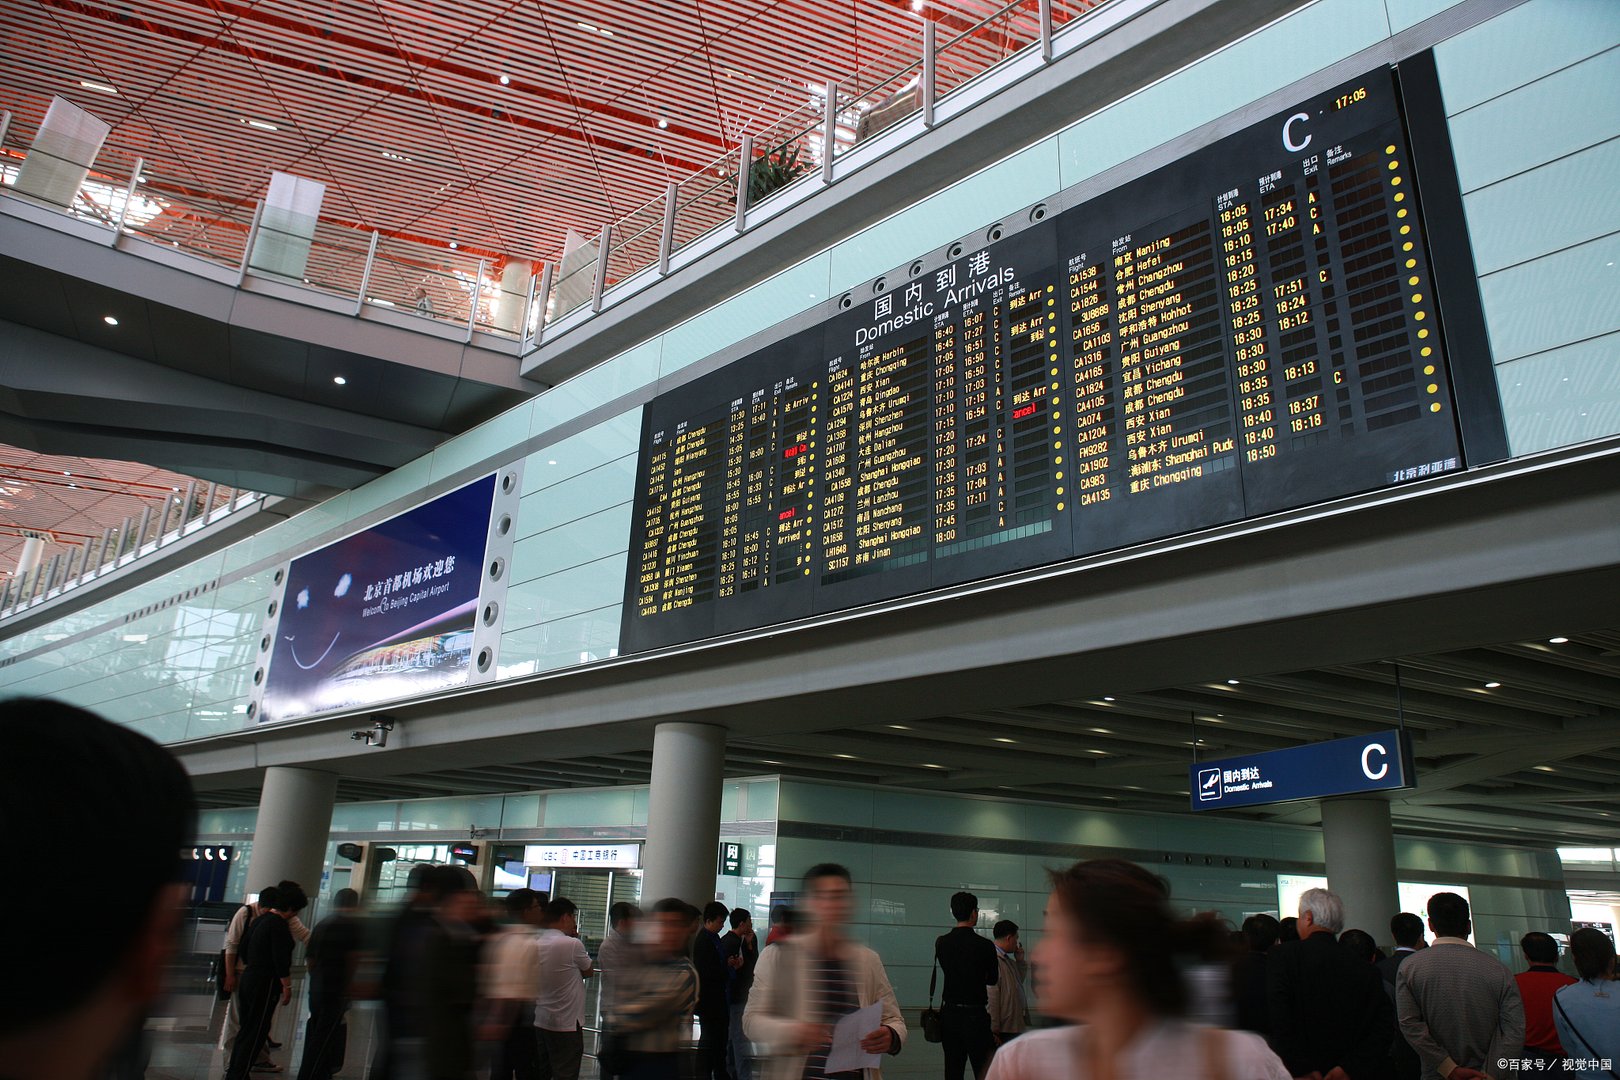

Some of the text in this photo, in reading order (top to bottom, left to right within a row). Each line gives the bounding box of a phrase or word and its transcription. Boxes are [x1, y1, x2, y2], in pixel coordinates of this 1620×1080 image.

[1336, 88, 1366, 109] 17:05
[1282, 113, 1312, 152] C
[1303, 155, 1318, 167] 出口
[1304, 165, 1318, 176] Exit
[1327, 151, 1352, 166] Remarks
[1218, 201, 1232, 211] STA
[1260, 183, 1275, 194] ETA
[1070, 204, 1247, 284] CA1538 南京 Nanjing 18:05
[1070, 192, 1315, 298] CA1544 合肥 Hefei 18:05 17:34 A
[1072, 208, 1317, 312] CA1826 常州 Changzhou 18:10 17:40 C
[1112, 245, 1128, 255] From
[1118, 294, 1136, 310] 成都
[1140, 280, 1174, 300] Chengdu
[1226, 248, 1252, 267] 18:15
[1313, 223, 1320, 234] A
[874, 251, 990, 321] 国内到港
[1069, 263, 1084, 273] Flight
[855, 267, 1014, 346] Domestic Arrivals
[1073, 264, 1254, 340] CA1656 沈阳 Shenyang 18:20
[1074, 271, 1326, 368] CA1316 广州 Guangzhou 18:25 17:51 C
[1083, 279, 1256, 351] CA1103 呼和浩特 Hohhot 18:25
[883, 347, 903, 361] Harbin
[964, 312, 983, 328] 16:07
[1010, 295, 1025, 310] 到达
[1029, 290, 1042, 301] Arr
[1075, 295, 1305, 384] CA4165 贵阳 Guiyang 18:25 18:24
[875, 340, 982, 388] Xian 16:51
[876, 326, 983, 376] Chongqing 17:27
[1076, 312, 1308, 398] CA1824 宜昌 Yichang 18:30 18:12
[875, 352, 984, 400] Qingdao 16:50
[888, 365, 984, 408] Urumqi 16:50
[1077, 344, 1264, 413] CA4105 成都 Chengdu 18:30
[1078, 360, 1265, 428] CA074 成都 Chengdu 18:30
[874, 379, 984, 426] Shenzhen 17:03
[874, 393, 984, 438] Hangzhou 17:19
[1078, 362, 1315, 443] CA1204 西安 Xian 18:35 18:13
[1080, 372, 1341, 458] FM9282 西安 Xian 18:35 C
[874, 406, 985, 452] Dalian 16:54
[1080, 396, 1318, 474] CA1902 乌鲁木齐 Urumqi 18:40 18:37
[861, 434, 985, 482] Shanghai Hongqiao 17:24
[874, 448, 906, 464] Guangzhou
[1081, 414, 1321, 490] CA983 Shanghai 18:40 18:18
[1394, 458, 1456, 482] 北京利亚德
[873, 476, 898, 491] Chengdu
[873, 477, 986, 518] Nanchang 17:04
[874, 462, 986, 504] Lanzhou 17:03
[1082, 445, 1275, 506] CA4135 重庆 Chongqing 18:50
[873, 492, 986, 531] Shenyang 17:11
[778, 531, 800, 545] Arrived
[859, 526, 920, 549] Shanghai Hongqiao
[872, 548, 890, 559] Jinan
[364, 556, 455, 601] 北京首都机场欢迎您
[391, 597, 408, 609] Beijing
[410, 588, 428, 603] Capital
[430, 582, 449, 596] Airport
[674, 597, 692, 609] Chengdu
[1223, 766, 1260, 784] 国内到达
[1361, 744, 1388, 780] C
[1224, 780, 1272, 793] Domestic Arrivals
